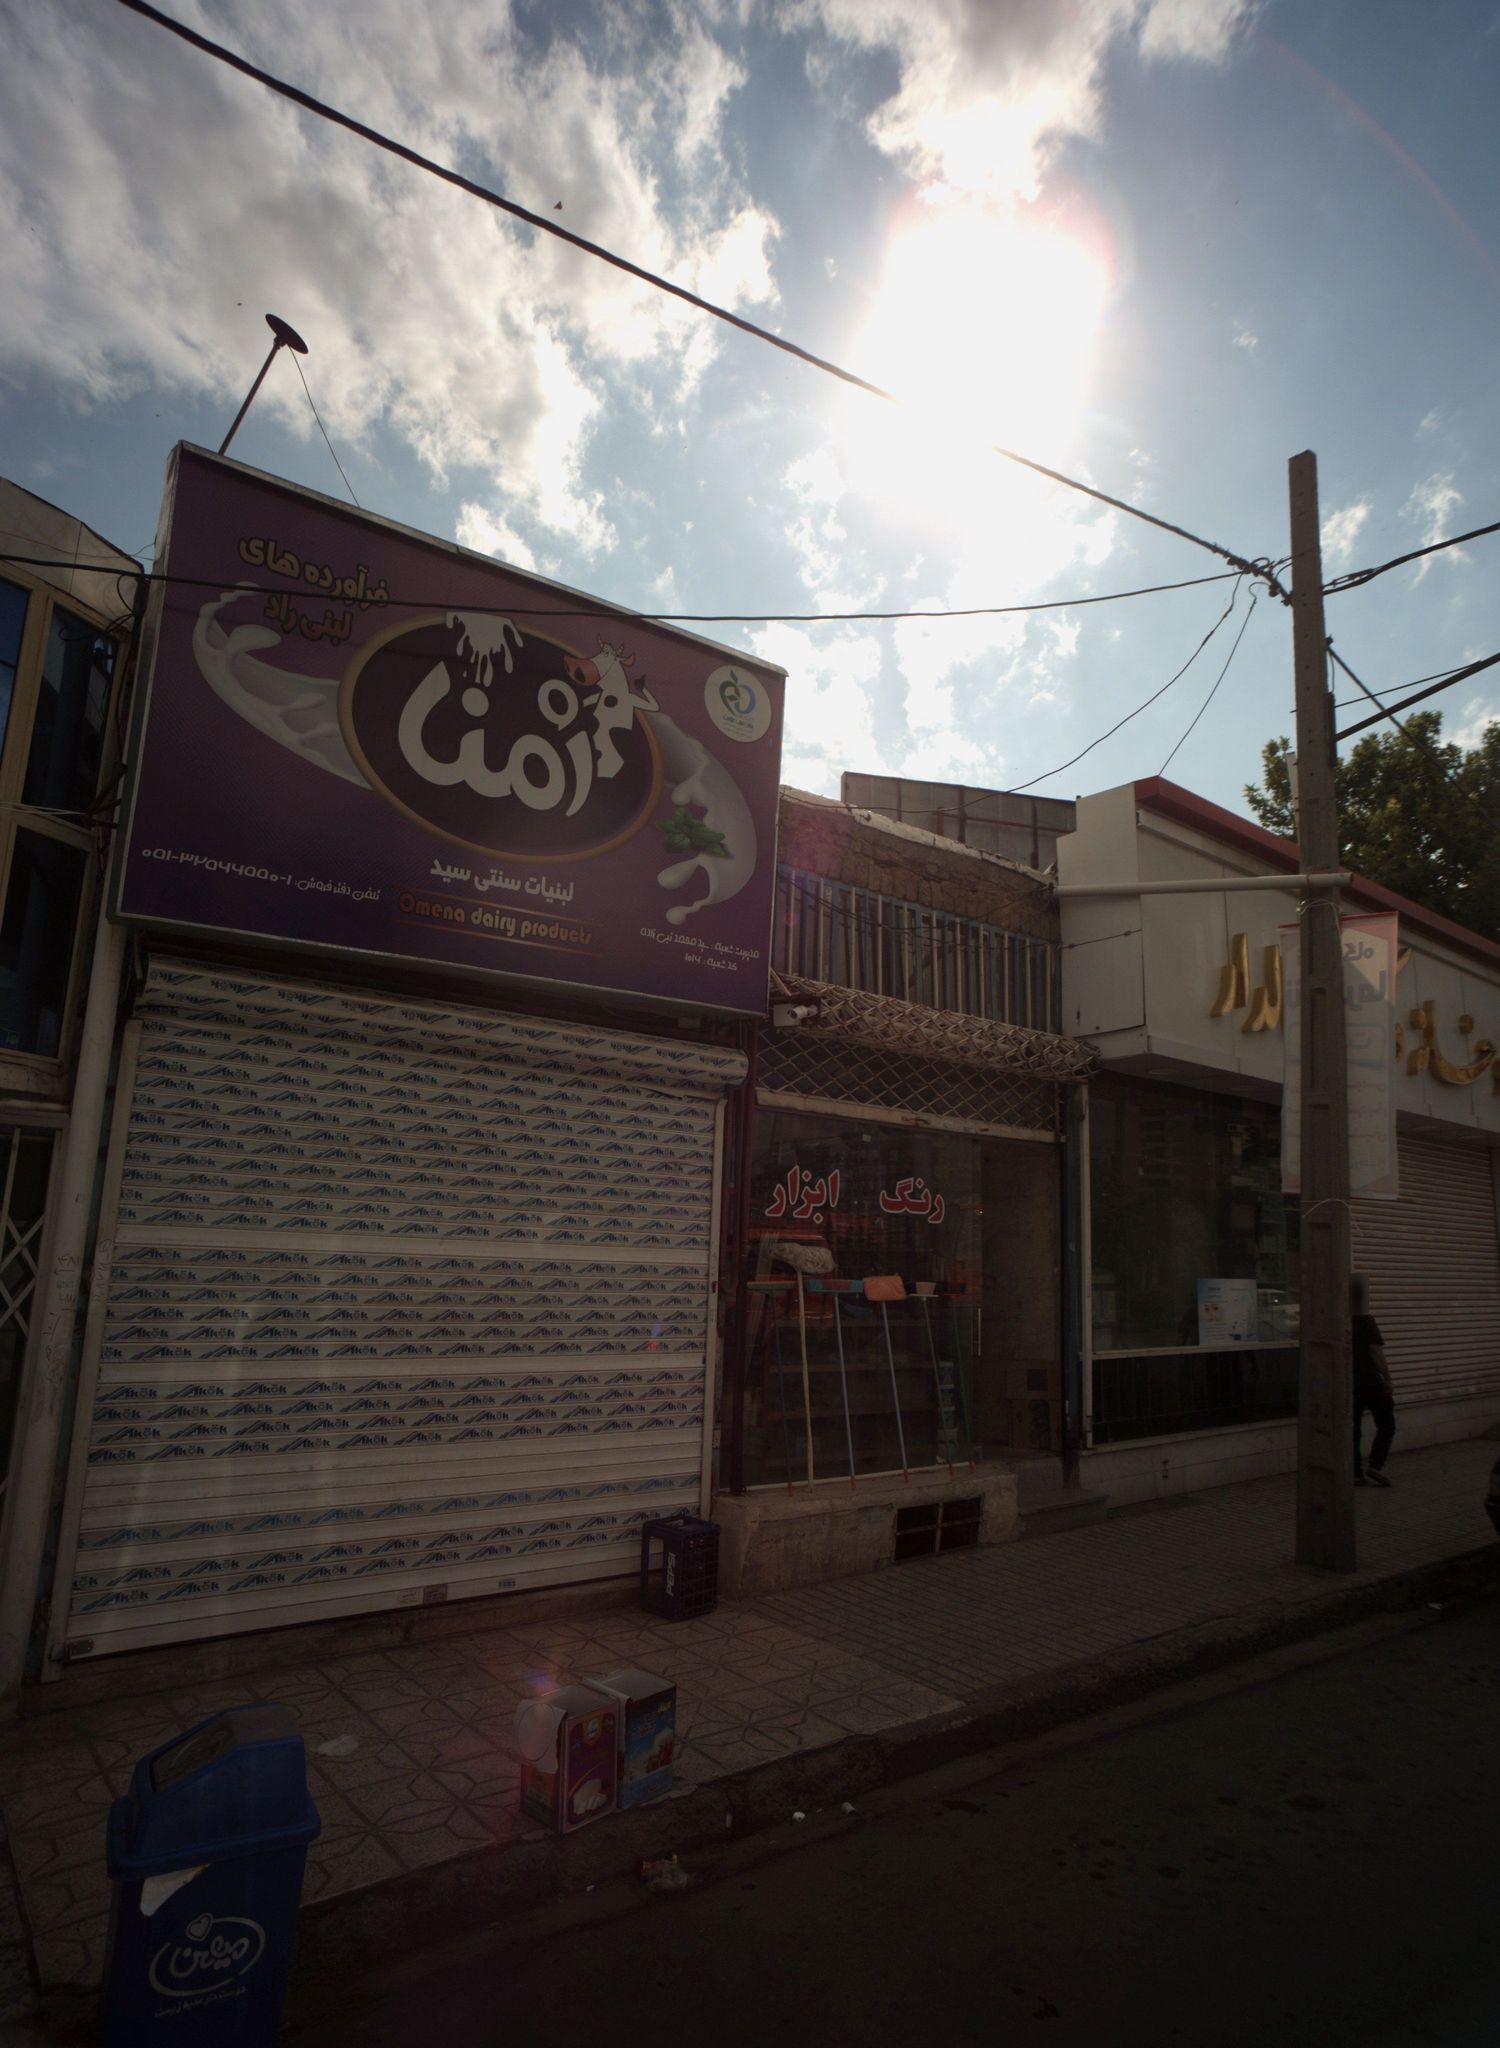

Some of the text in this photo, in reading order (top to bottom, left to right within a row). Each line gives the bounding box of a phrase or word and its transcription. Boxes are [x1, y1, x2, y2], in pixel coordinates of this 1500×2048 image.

[237, 536, 390, 612] فرآورده های
[263, 591, 354, 647] لبنی راد
[333, 881, 351, 895] دفتر
[352, 886, 381, 901] تلفن
[430, 858, 575, 907] لبنیات سنتی سید
[400, 890, 593, 945] Omena dairy products
[764, 1164, 945, 1225] رنگ ابزار
[665, 1551, 678, 1597] PEPSI
